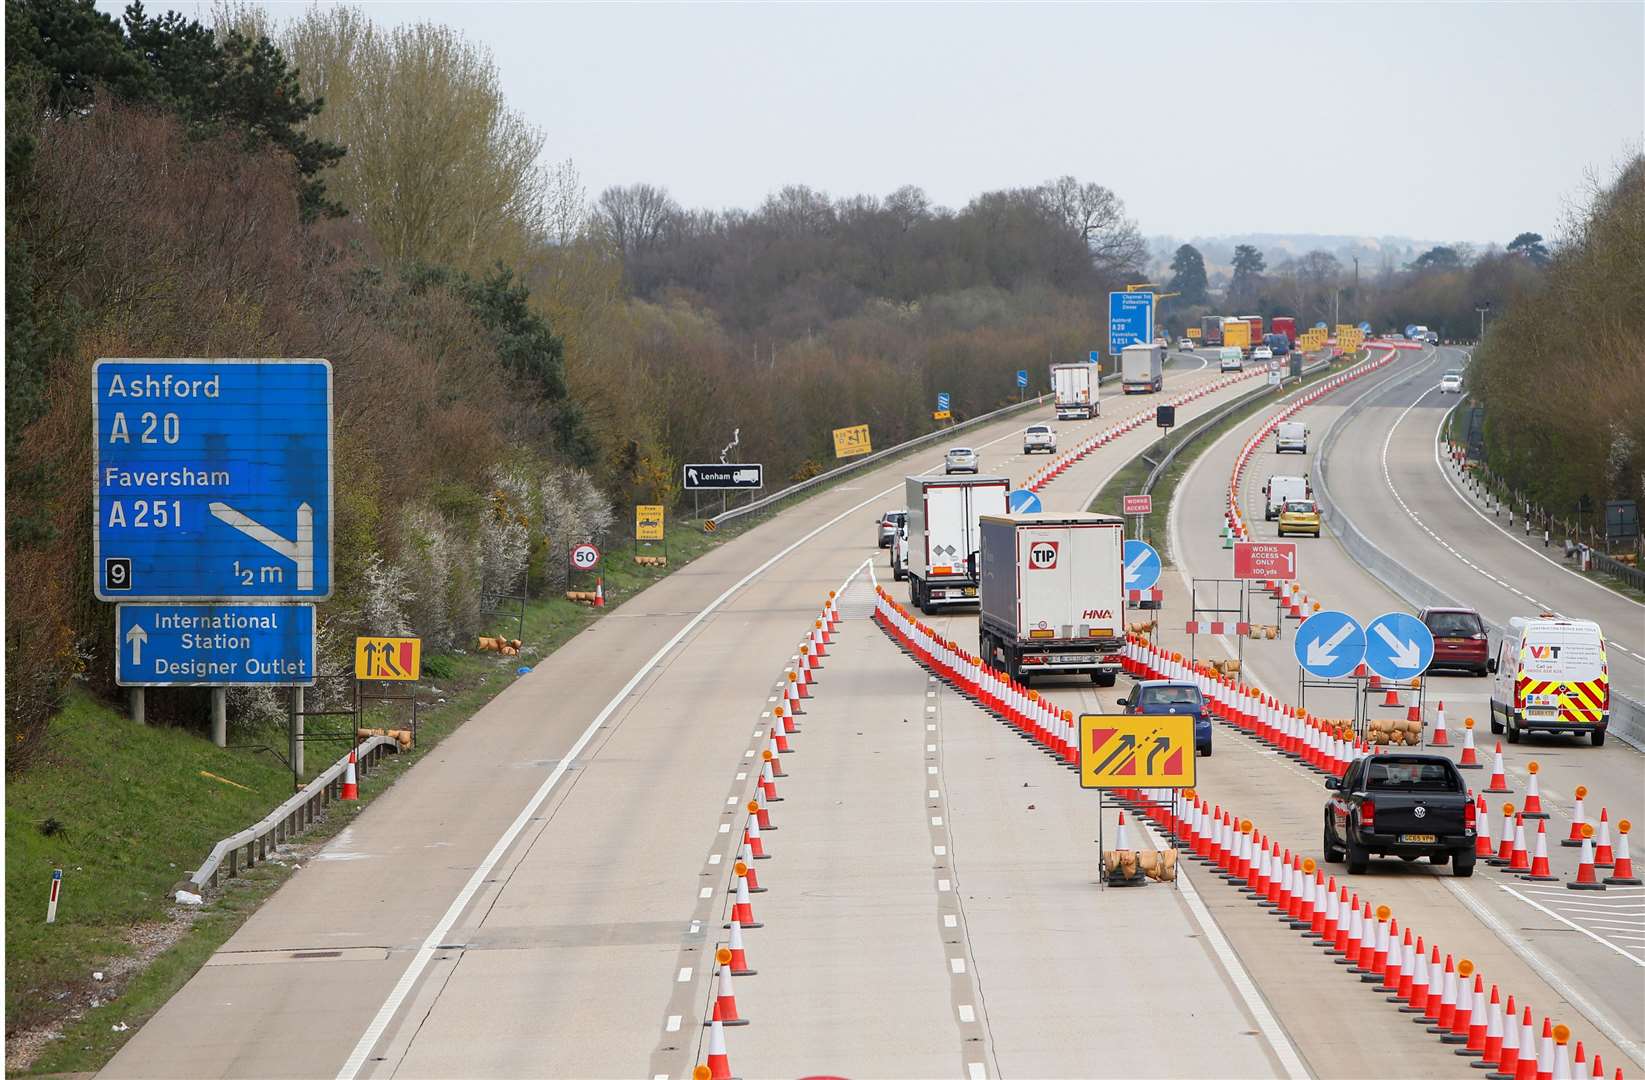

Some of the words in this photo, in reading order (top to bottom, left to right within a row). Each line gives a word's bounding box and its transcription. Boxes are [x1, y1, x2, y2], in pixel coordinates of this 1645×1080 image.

[108, 374, 220, 398] Ashford
[105, 467, 230, 487] Faversham
[700, 472, 731, 480] Lenham
[576, 551, 595, 563] 50
[1033, 550, 1055, 562] TIP
[111, 563, 126, 584] 9
[155, 613, 278, 629] International
[1082, 609, 1113, 619] HNA
[181, 633, 250, 649] Station
[155, 659, 238, 677] Designer
[245, 658, 305, 675] Outlet
